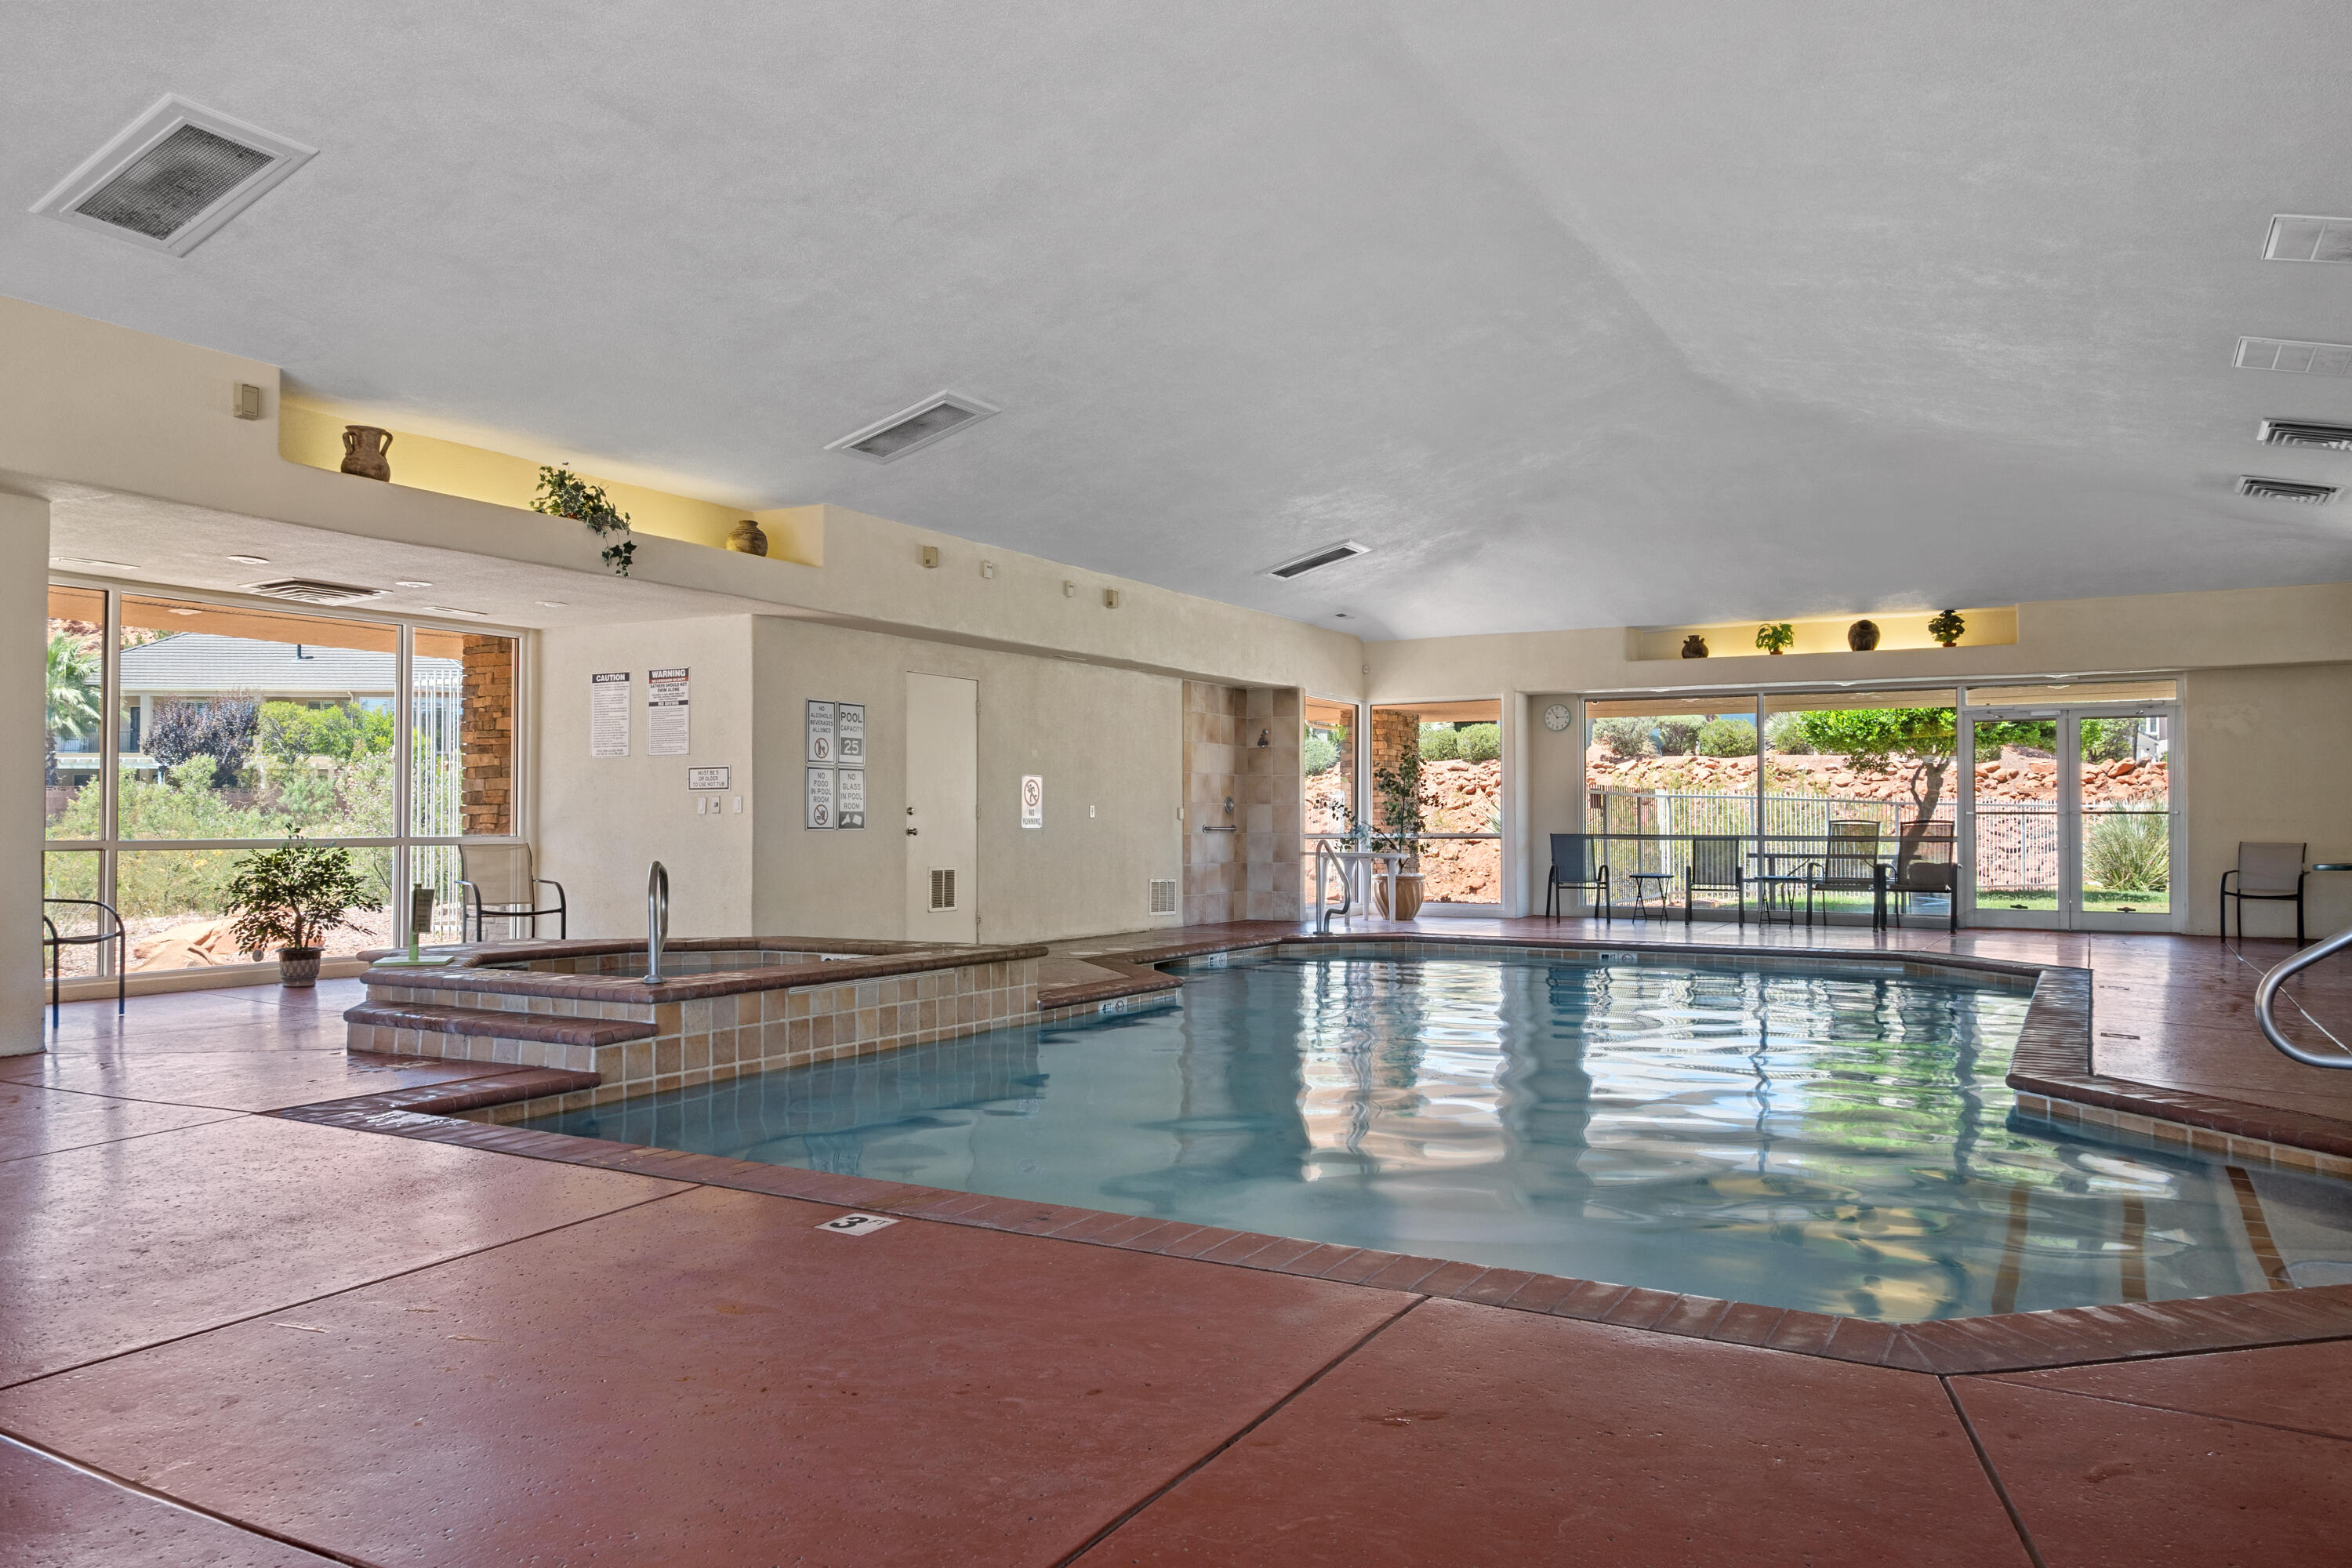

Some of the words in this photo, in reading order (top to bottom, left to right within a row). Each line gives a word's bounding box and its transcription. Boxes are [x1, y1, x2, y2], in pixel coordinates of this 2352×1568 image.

[596, 674, 625, 682] CAUTION
[652, 669, 686, 678] WARNING
[841, 712, 862, 723] POOL
[844, 740, 859, 754] 25
[829, 1217, 869, 1228] 3
